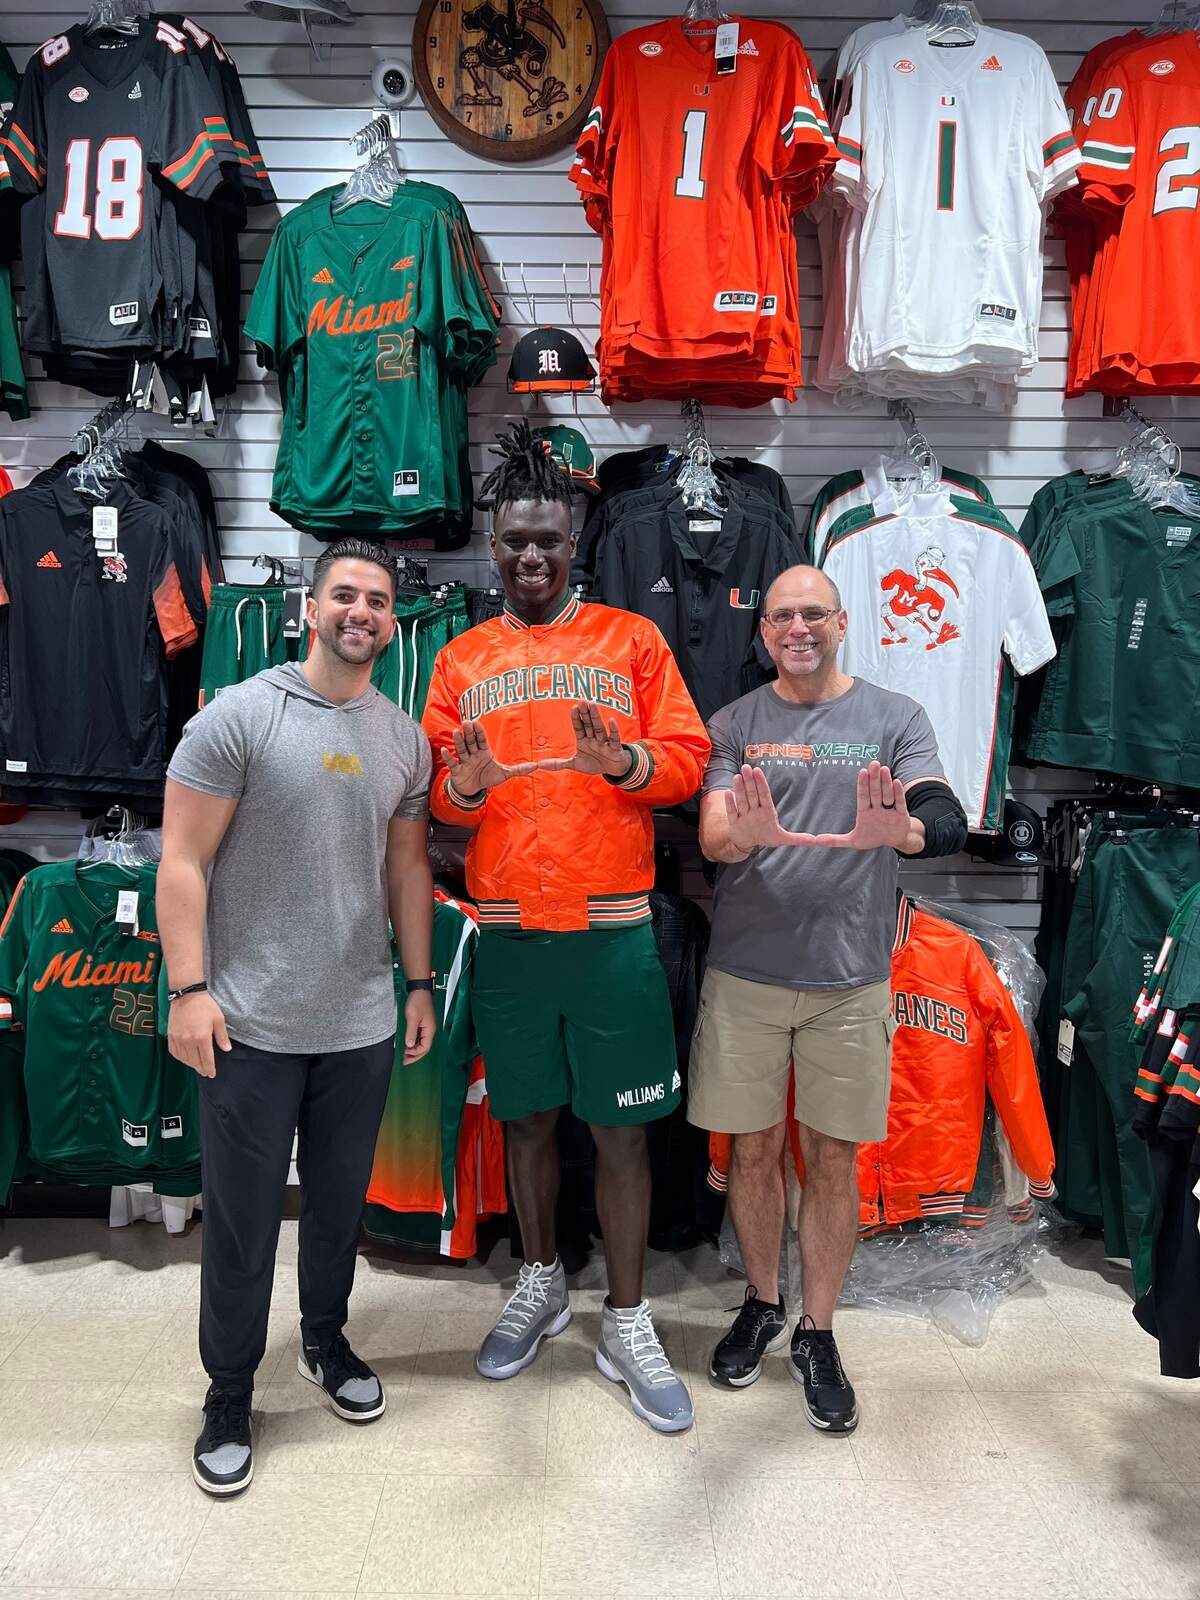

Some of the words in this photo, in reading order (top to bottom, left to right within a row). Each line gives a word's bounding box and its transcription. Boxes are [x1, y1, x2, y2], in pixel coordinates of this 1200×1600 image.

[440, 1, 452, 13] 10
[576, 7, 583, 19] 2
[429, 37, 437, 49] 9
[585, 44, 593, 56] 3
[437, 77, 445, 89] 8
[575, 84, 583, 95] 4
[466, 112, 473, 123] 7
[545, 114, 553, 126] 5
[505, 123, 513, 136] 6
[674, 109, 708, 200] 1
[936, 119, 957, 212] 1
[1152, 125, 1200, 218] 2
[54, 136, 143, 241] 18
[307, 281, 414, 336] Miami
[729, 588, 760, 609] U
[898, 590, 919, 607] M
[745, 742, 880, 760] CANESWEAR
[32, 949, 156, 993] Miami
[109, 988, 156, 1037] 22
[890, 992, 968, 1044] ANES
[616, 1083, 665, 1108] WILLIAMS
